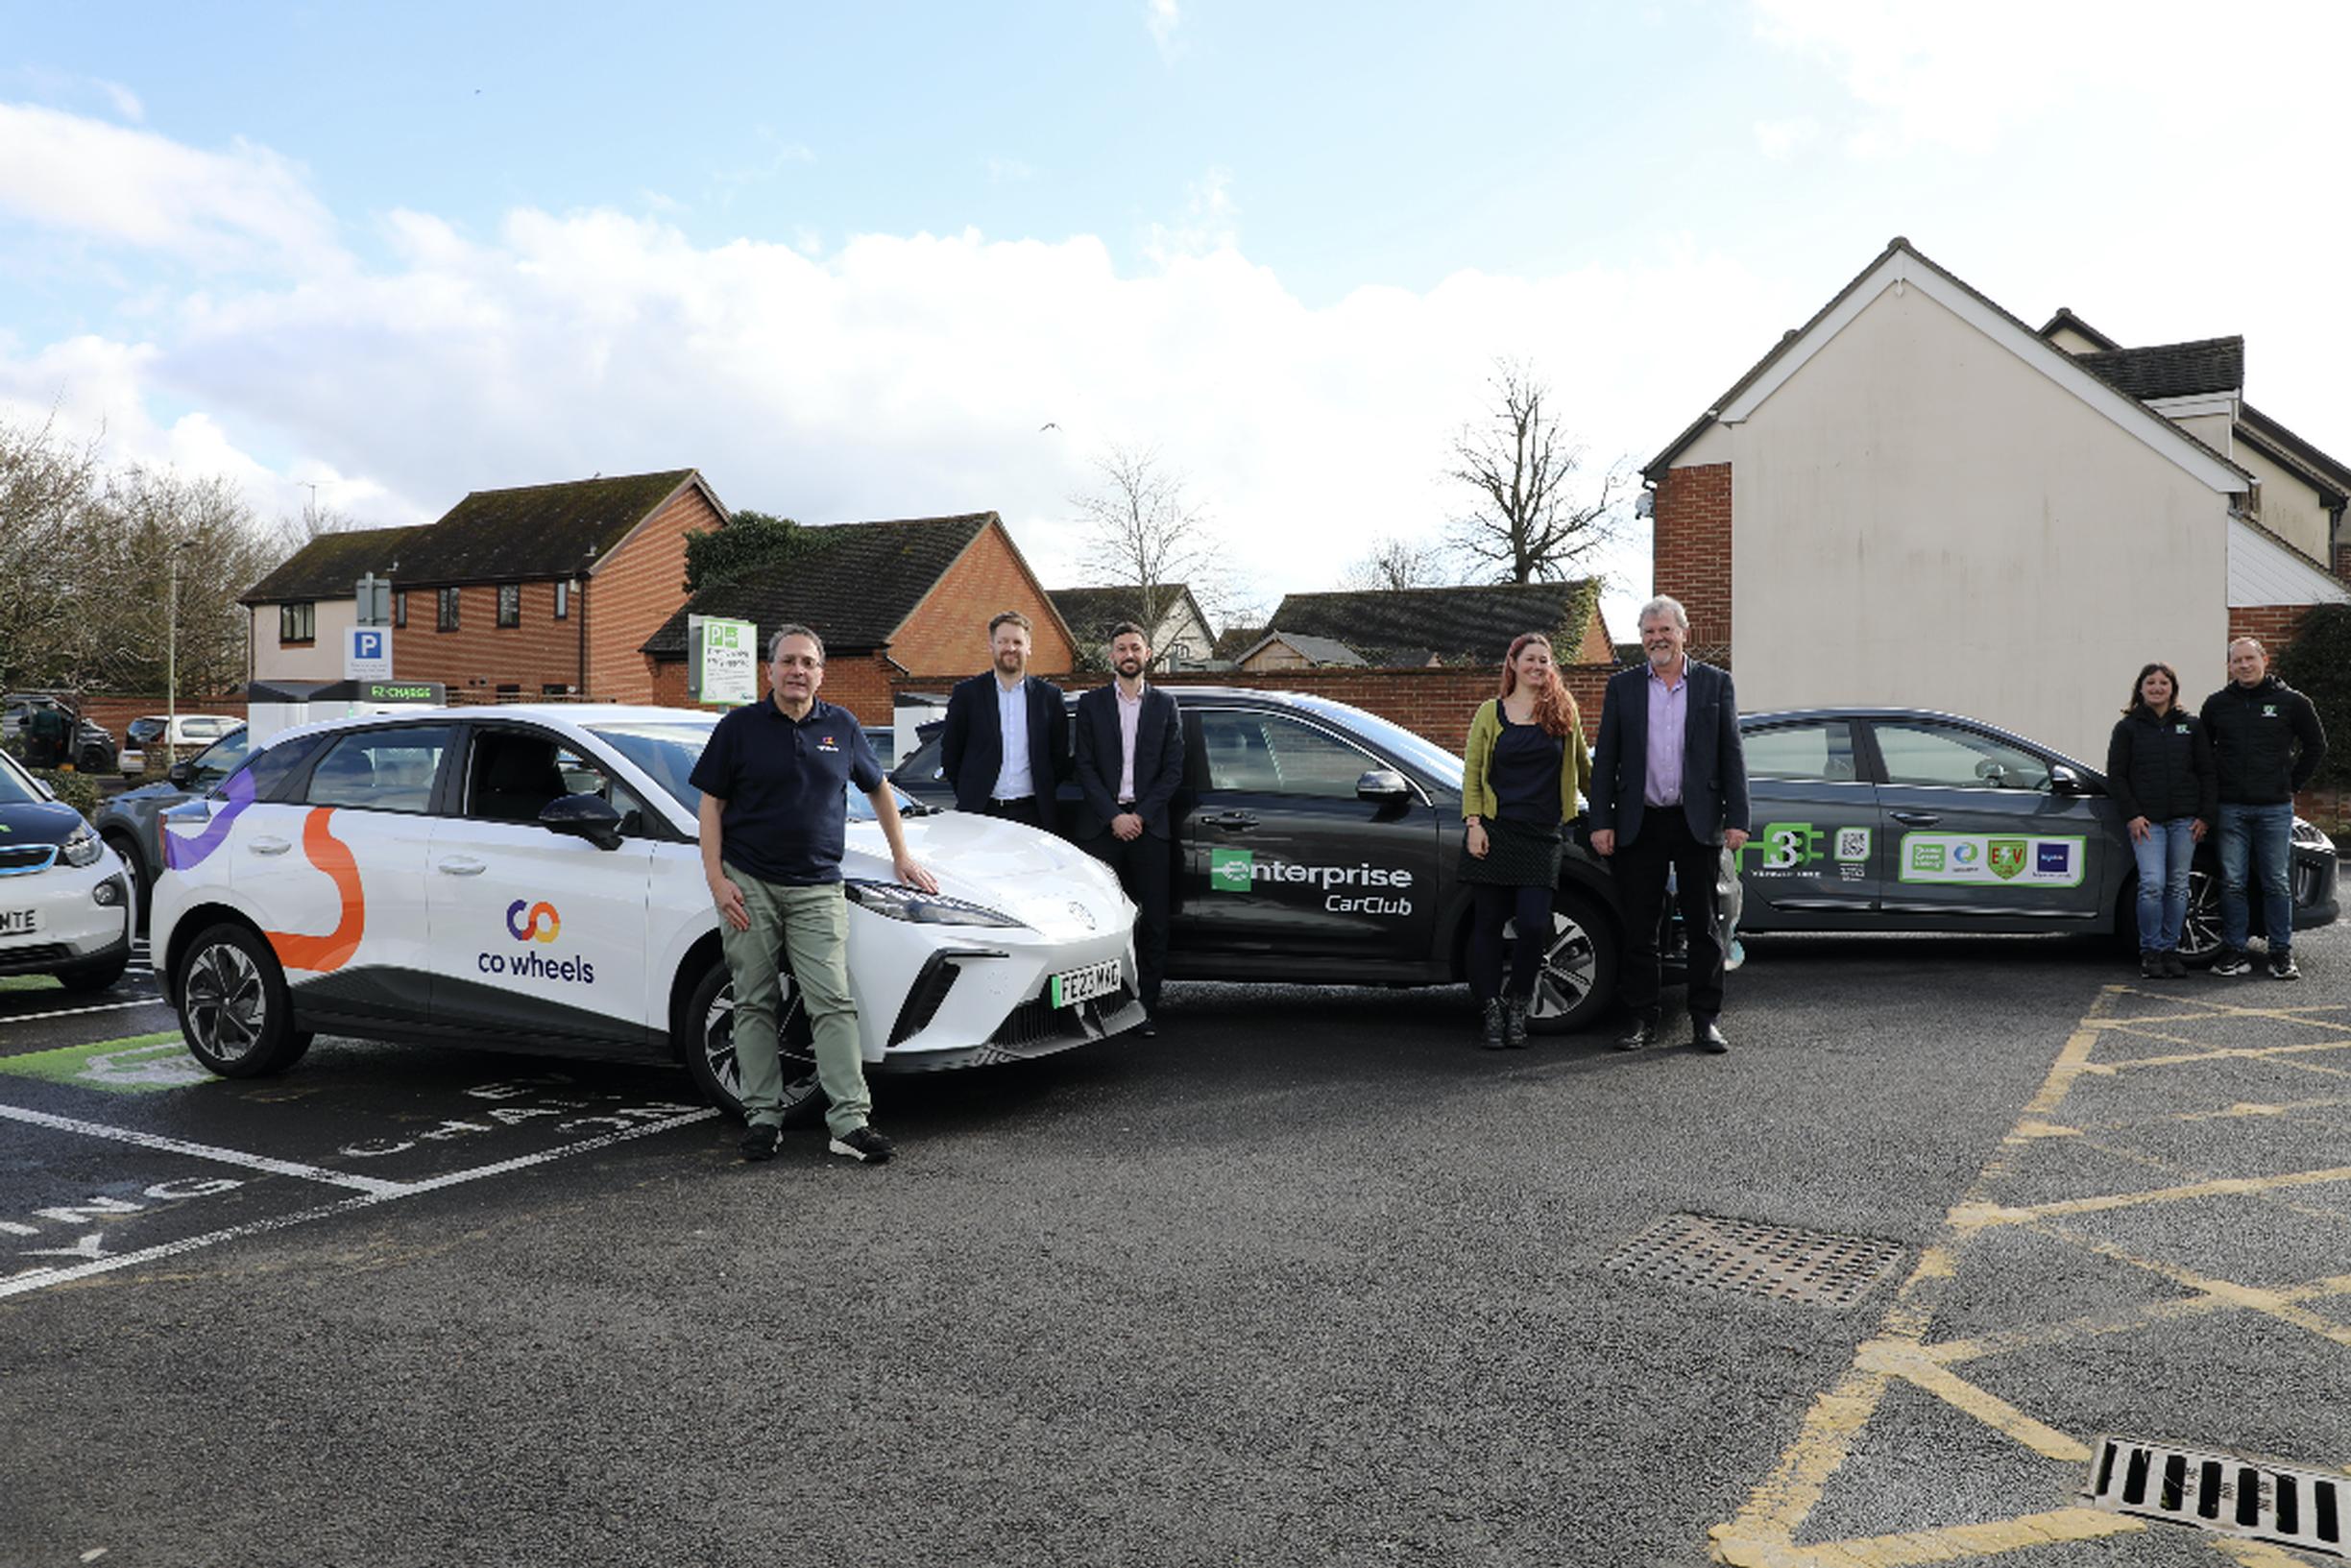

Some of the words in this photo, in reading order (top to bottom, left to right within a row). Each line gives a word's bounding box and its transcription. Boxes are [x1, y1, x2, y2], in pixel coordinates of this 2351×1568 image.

[361, 635, 376, 657] P
[1214, 859, 1414, 890] enterprise
[1325, 894, 1412, 915] CarClub
[478, 953, 505, 974] co
[510, 951, 594, 984] wheels
